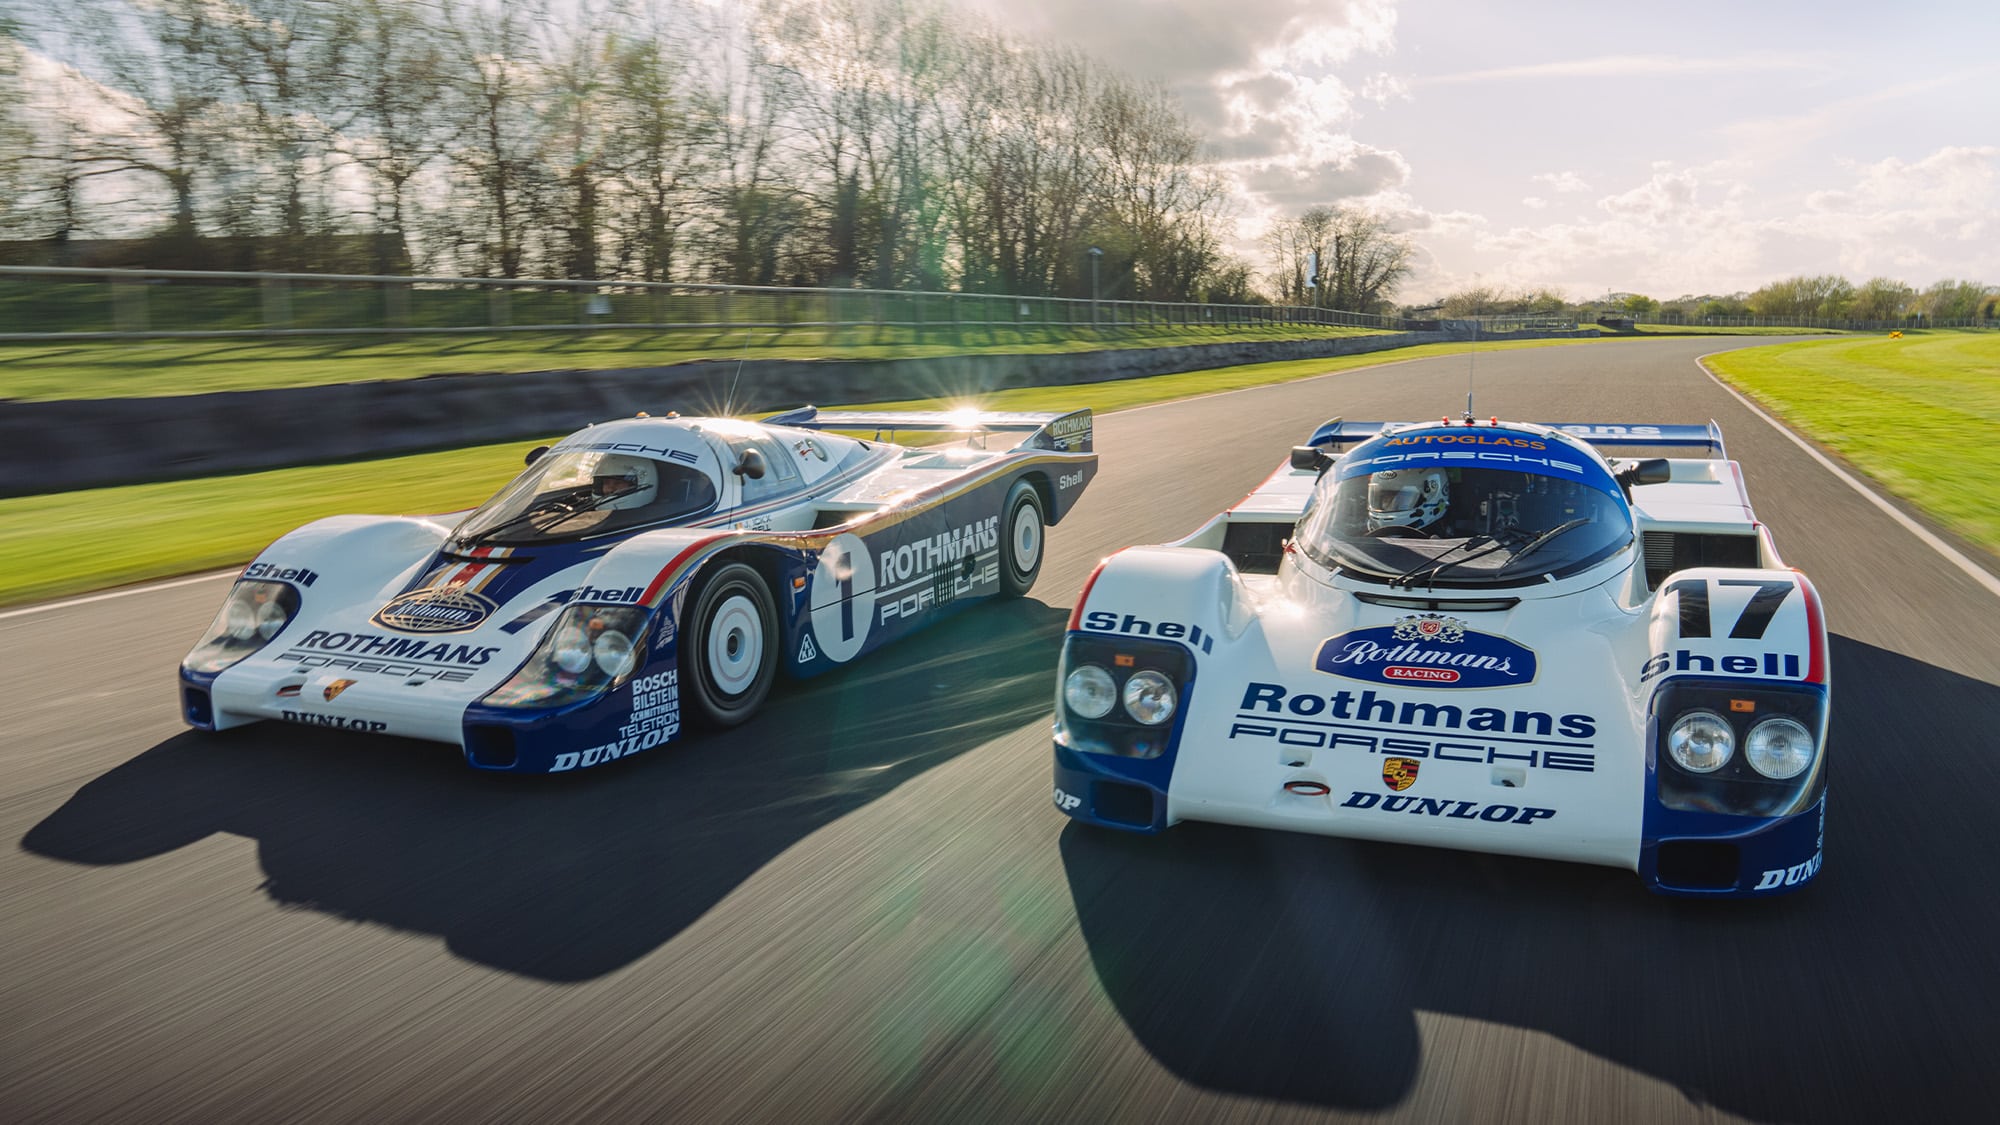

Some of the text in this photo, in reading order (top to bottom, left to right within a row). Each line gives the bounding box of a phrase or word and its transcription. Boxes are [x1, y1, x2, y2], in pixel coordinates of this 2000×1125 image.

[1053, 416, 1092, 436] ROTHMANS
[1384, 435, 1546, 450] AUTOGLASS
[1342, 452, 1584, 474] PORSCHE
[1060, 469, 1082, 490] Shell
[880, 515, 999, 588] ROTHMANS
[246, 563, 319, 588] Shell
[836, 551, 854, 643] 1
[1664, 579, 1795, 640] 17
[296, 630, 501, 666] ROTHMANS
[1085, 611, 1213, 656] Shell
[273, 653, 475, 683] PORSCHE
[1332, 640, 1518, 676] Rothmans
[1641, 650, 1799, 683] Shell
[632, 670, 678, 696] BOSCH
[1393, 669, 1452, 680] RACING
[633, 685, 679, 711] BILSTEIN
[1240, 682, 1596, 739] Rothmans
[281, 710, 387, 731] DUNLOP
[619, 710, 680, 739] TELETRON
[549, 723, 680, 773] DUNLOP
[1229, 723, 1595, 772] PORSCHE
[1340, 791, 1556, 825] DUNLOP
